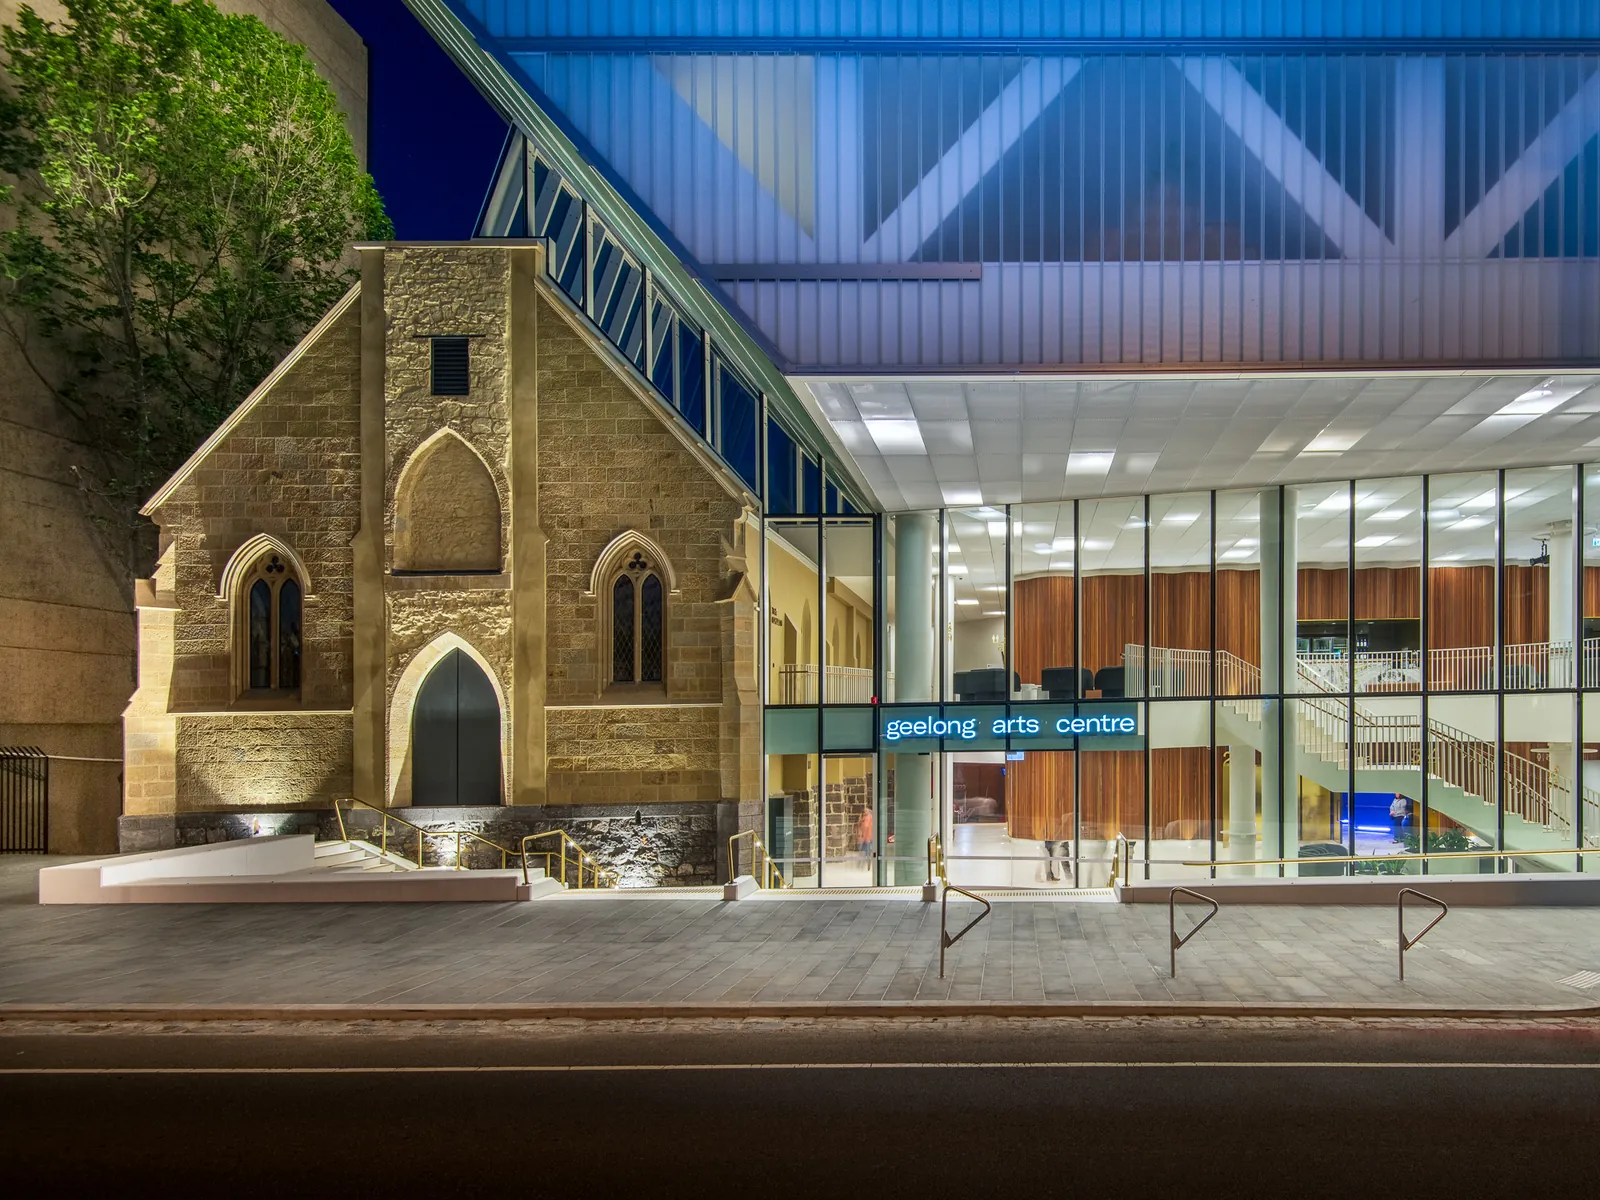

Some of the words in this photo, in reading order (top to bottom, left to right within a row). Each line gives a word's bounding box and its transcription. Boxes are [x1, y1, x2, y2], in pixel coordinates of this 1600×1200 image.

[886, 715, 976, 740] geelong
[992, 716, 1039, 734] arts
[1056, 714, 1135, 733] centre
